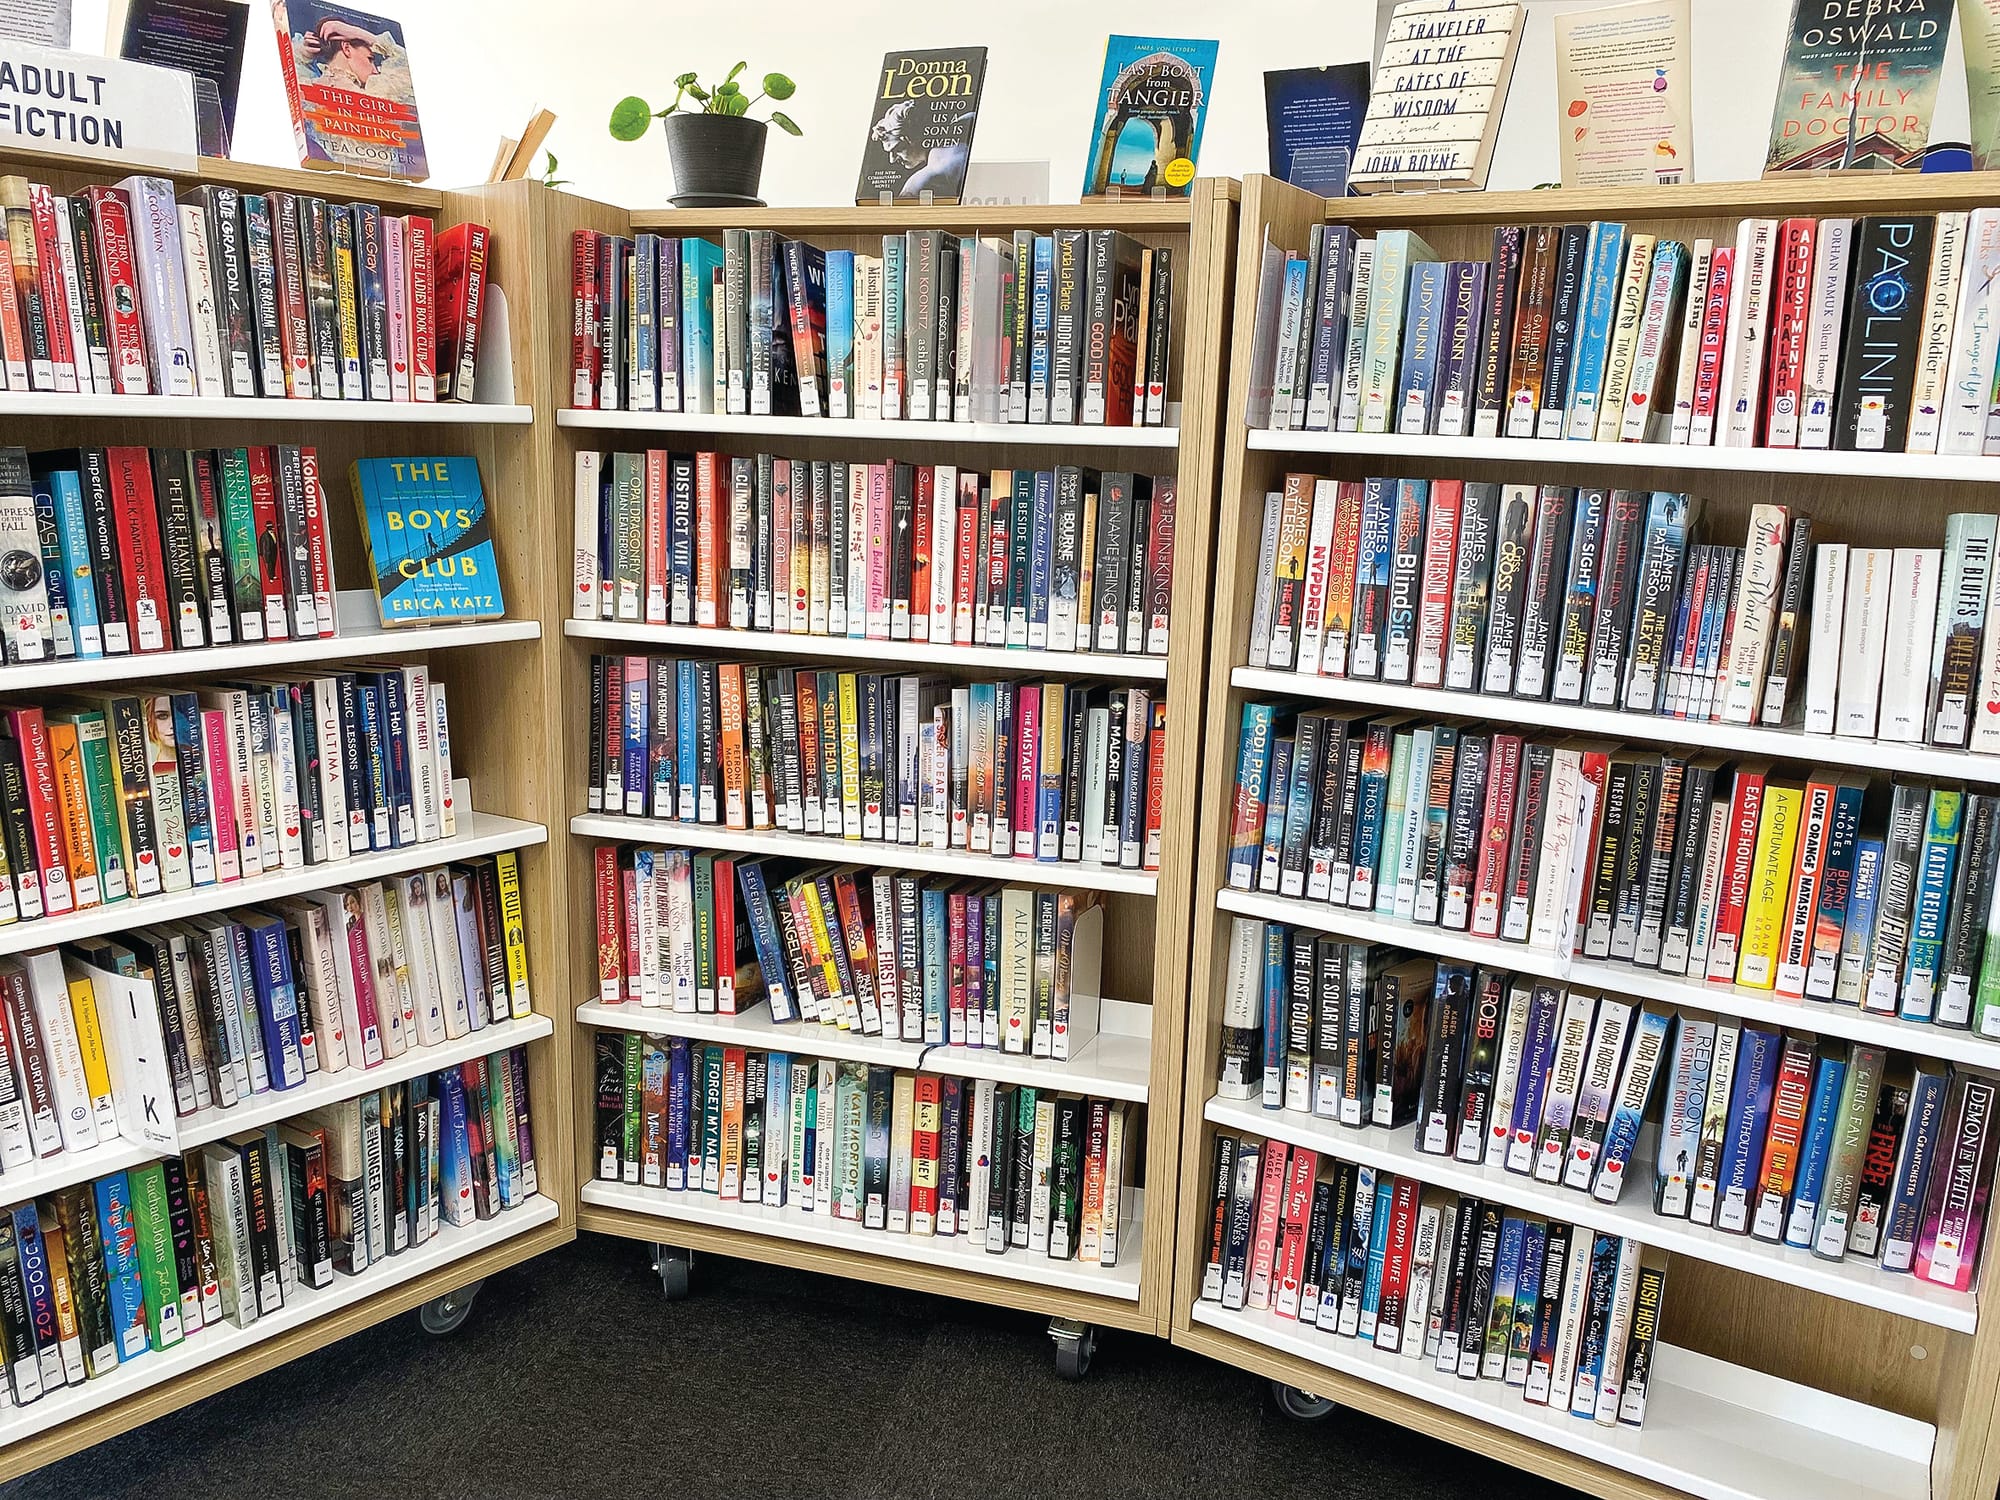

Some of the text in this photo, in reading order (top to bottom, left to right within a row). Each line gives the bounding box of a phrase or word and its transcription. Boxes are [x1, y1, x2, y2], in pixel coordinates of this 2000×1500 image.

[1408, 18, 1486, 39] TRAVELER
[1803, 21, 1938, 47] OSWALD
[1824, 0, 1925, 20] DEBRA
[0, 61, 106, 105] ADULT
[881, 69, 973, 99] Leon
[898, 58, 967, 76] Donna
[1119, 63, 1204, 78] LAST BOAT
[1146, 77, 1170, 88] from
[1395, 71, 1469, 92] GATES OF
[1411, 46, 1466, 64] AT THE
[1833, 62, 1892, 81] THE
[320, 89, 397, 114] THE GIRL
[338, 108, 385, 124] IN THE
[930, 101, 966, 110] UNTO
[932, 113, 959, 123] US A
[1107, 88, 1205, 107] TANGIER
[1393, 99, 1458, 117] WISDOM
[1783, 115, 1919, 138] DOCTOR
[1801, 88, 1913, 110] FAMILY
[320, 139, 350, 153] TEA
[356, 147, 416, 165] COOPER
[324, 118, 402, 141] PAINTING
[922, 139, 960, 148] GIVEN
[924, 125, 963, 135] SON IS
[1361, 153, 1460, 173] JOHN BOYNE
[364, 210, 378, 274] Alex Gray
[413, 228, 429, 361] FAIRVALE LADIES BOOK CLUB
[466, 231, 484, 318] THE TAO DECEPTION
[1016, 243, 1027, 348] JACKRABBIT SMILE
[1094, 238, 1108, 318] Lynda La Plante
[1689, 255, 1709, 329] Billy Sing
[914, 238, 929, 376] DEAN KOONTZ ashley
[1056, 315, 1072, 354] HIDDEN
[1451, 269, 1474, 360] JUDY NUNN
[1699, 265, 1727, 393] FAKE ACCOUNTS LAUREN
[1858, 223, 1915, 392] PAOLINI
[301, 454, 319, 518] Kokomo
[391, 463, 449, 482] THE
[33, 493, 58, 559] CRASH
[87, 452, 112, 561] imperfect women
[629, 477, 642, 575] OPAL DRAGONFLY
[674, 466, 689, 565] DISTRICT VIII
[1016, 480, 1028, 563] LIE BESIDE ME
[398, 557, 478, 579] CLUB
[1577, 493, 1602, 588] OUT OF SIGHT
[1644, 527, 1666, 607] PATTERSON
[1660, 546, 1676, 592] JAMES
[392, 595, 494, 612] ERICA KATZ
[1911, 554, 1923, 599] Elliot Perlman
[1957, 537, 1989, 617] THE BLUFFS
[232, 694, 248, 773] SALLY HEPWORTH
[386, 678, 400, 736] Anne Holt
[630, 690, 641, 743] BETTY
[702, 671, 711, 764] HAPPY EVER AFTER
[118, 729, 134, 776] SCANDAL
[127, 718, 145, 783] CHARLESTON
[324, 719, 339, 783] ULTIMA
[842, 723, 858, 797] FRAMED
[1021, 728, 1033, 782] MISTAKE
[1108, 725, 1121, 782] MALORIE
[1245, 712, 1268, 825] JODI PICOULT
[1608, 775, 1626, 825] TRESPASS
[1804, 792, 1826, 869] LOVE ORANGE
[501, 862, 521, 923] THE RULE
[606, 854, 615, 935] KIRSTY MANNING
[1918, 846, 1948, 938] KATHY REICHS
[901, 882, 916, 968] BRAD MELTZER
[236, 931, 256, 1014] GRAHAM ISON
[354, 928, 368, 984] Anna Jacobs
[1012, 908, 1028, 1017] ALEX MILLER
[1320, 957, 1341, 1051] THE SOLAR WAR
[706, 1063, 720, 1135] FORGET MY
[1622, 1032, 1660, 1110] NORA ROBERTS
[1770, 1051, 1812, 1147] THE GOOD LIE
[143, 1095, 160, 1125] K
[1035, 1107, 1048, 1162] MURPHY
[367, 1138, 381, 1194] HUNGER
[1087, 1104, 1103, 1208] HERE COME THE DOGS
[1217, 1140, 1231, 1199] CRAIG RUSSELL
[1948, 1088, 1988, 1212] DEMON IN WHITE
[145, 1175, 168, 1263] Rachael Johns
[249, 1149, 267, 1233] BEFORE HER EYES
[1389, 1185, 1411, 1284] THE POPPY WIFE
[1634, 1274, 1660, 1341] HUSH HUSH
